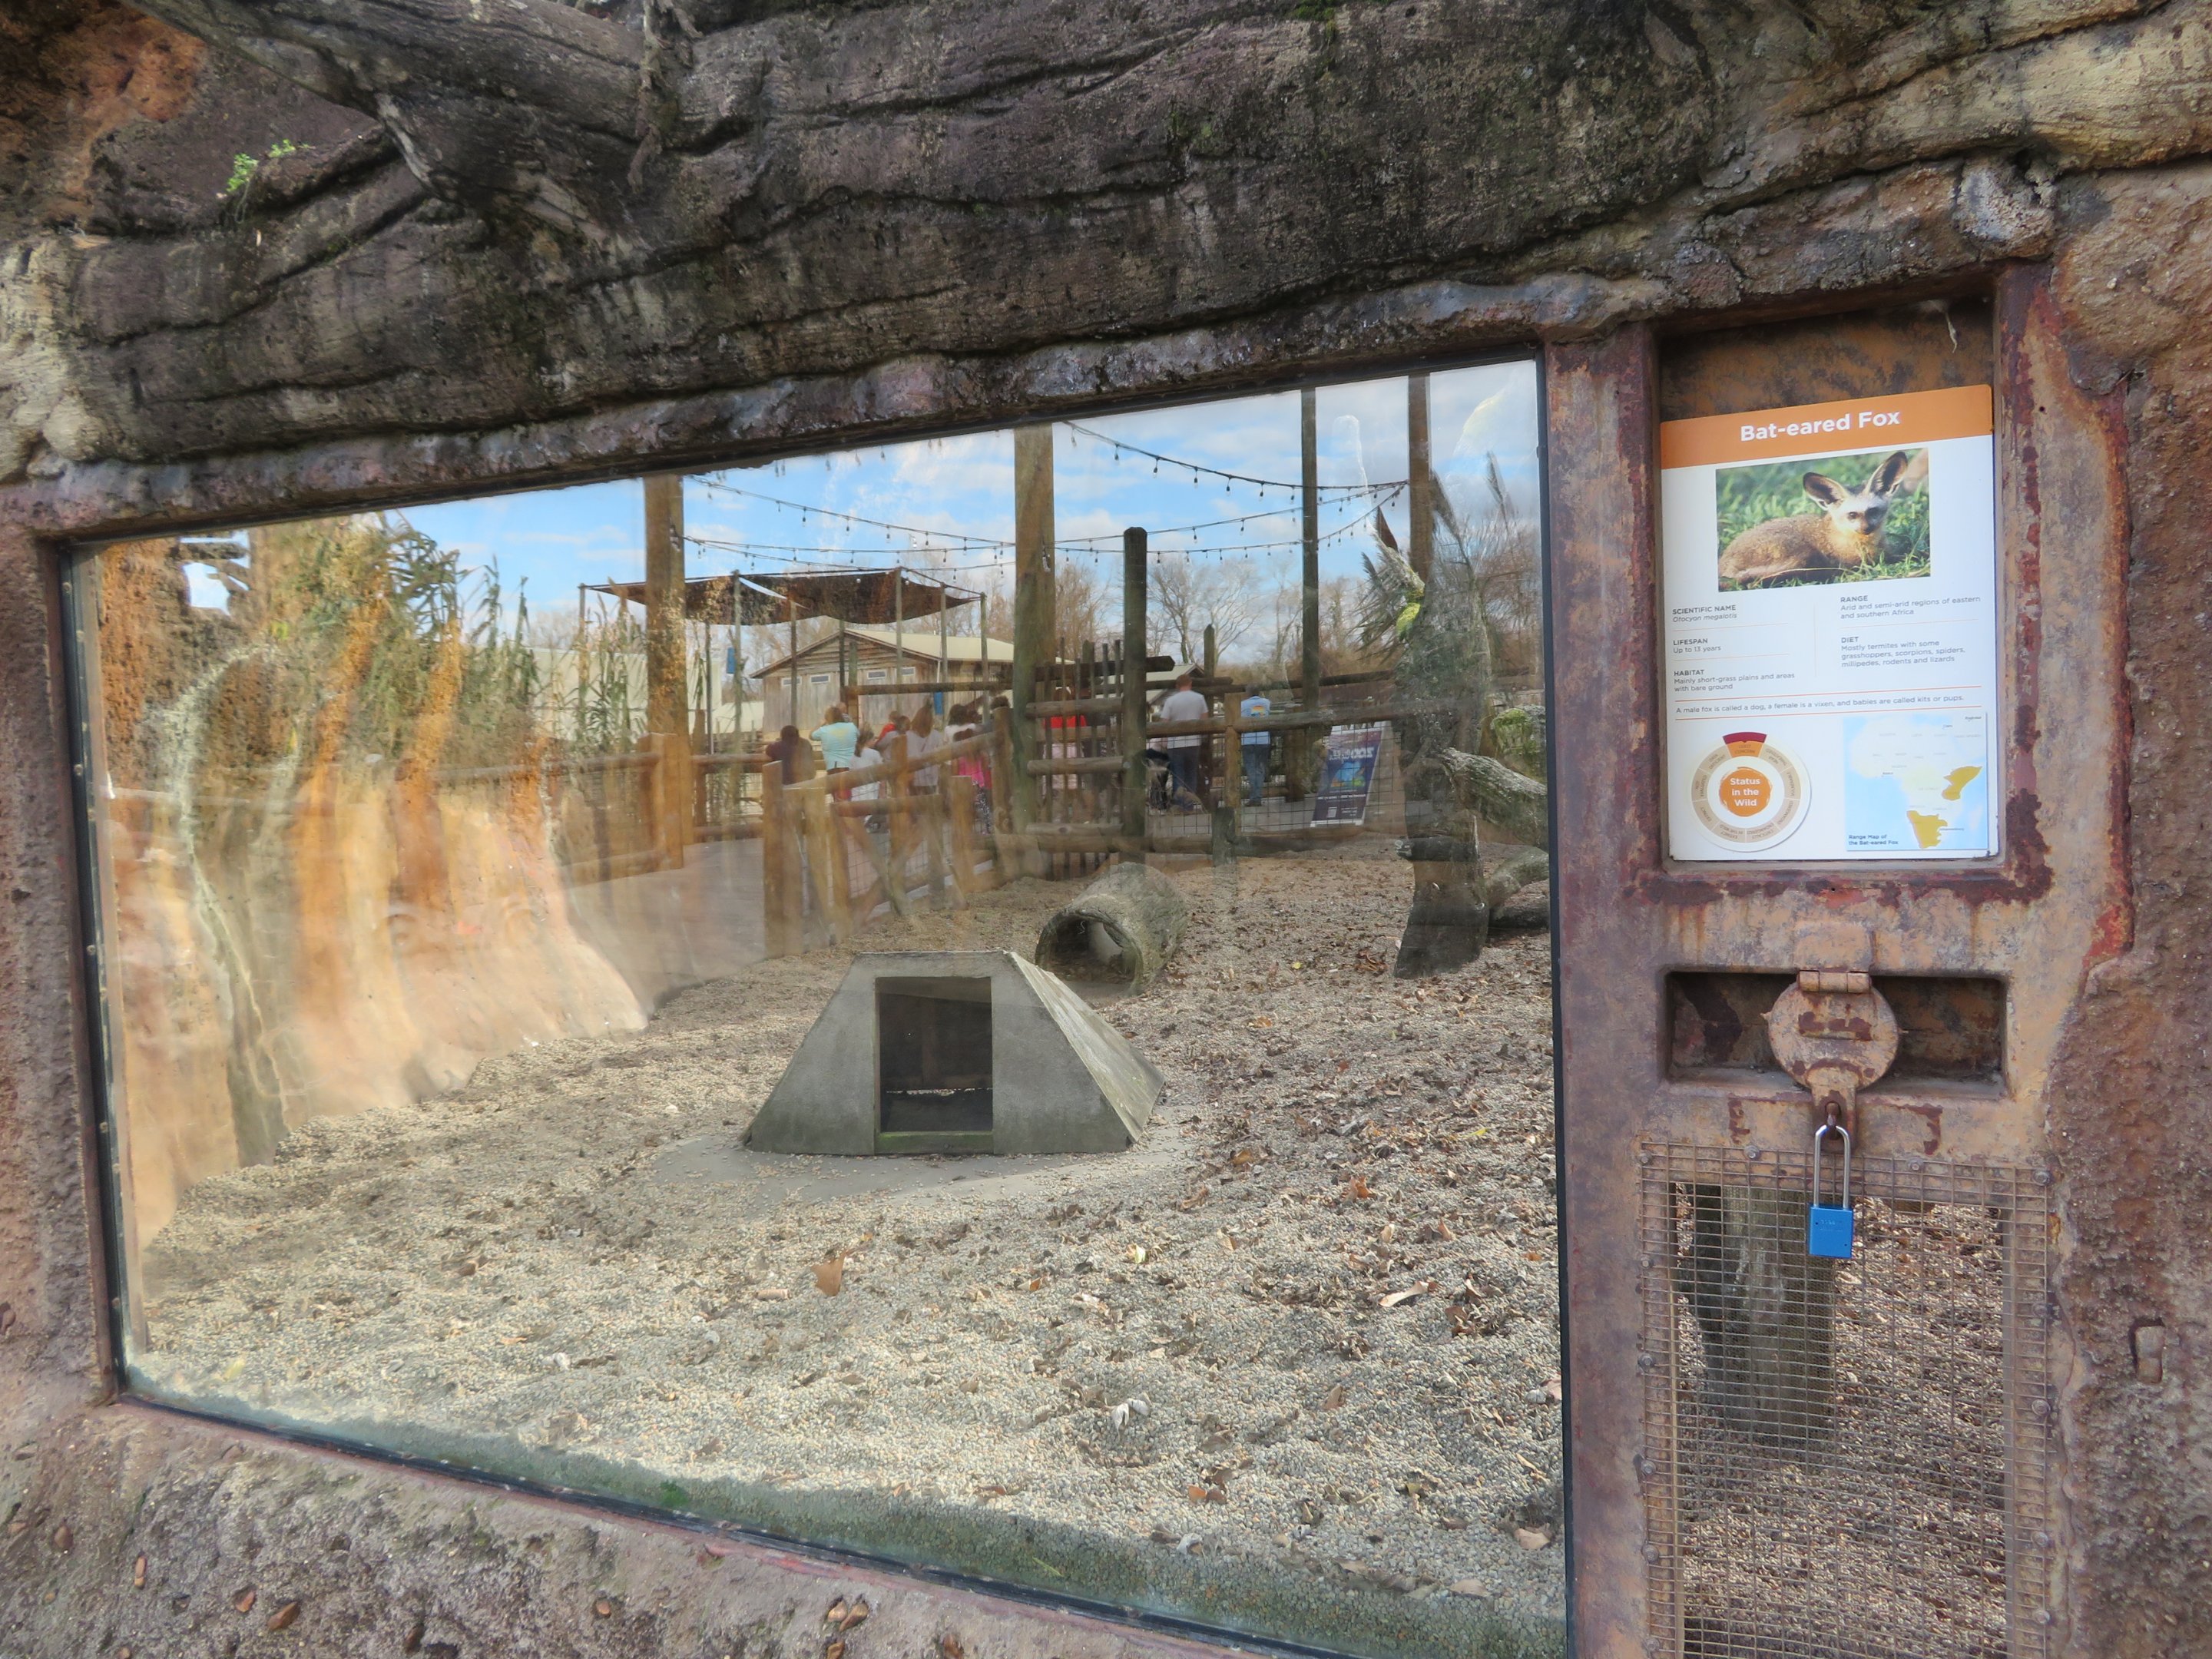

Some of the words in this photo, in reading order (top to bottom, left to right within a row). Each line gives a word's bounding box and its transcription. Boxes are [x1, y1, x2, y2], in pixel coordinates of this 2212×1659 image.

[1740, 414, 1850, 442] Bat-eared
[1859, 409, 1901, 429] Fox
[1673, 614, 1701, 623] Otocyon
[1842, 651, 1892, 660] grasshoppers,
[1697, 675, 1737, 684] short-grass
[1944, 694, 1964, 703] pups.
